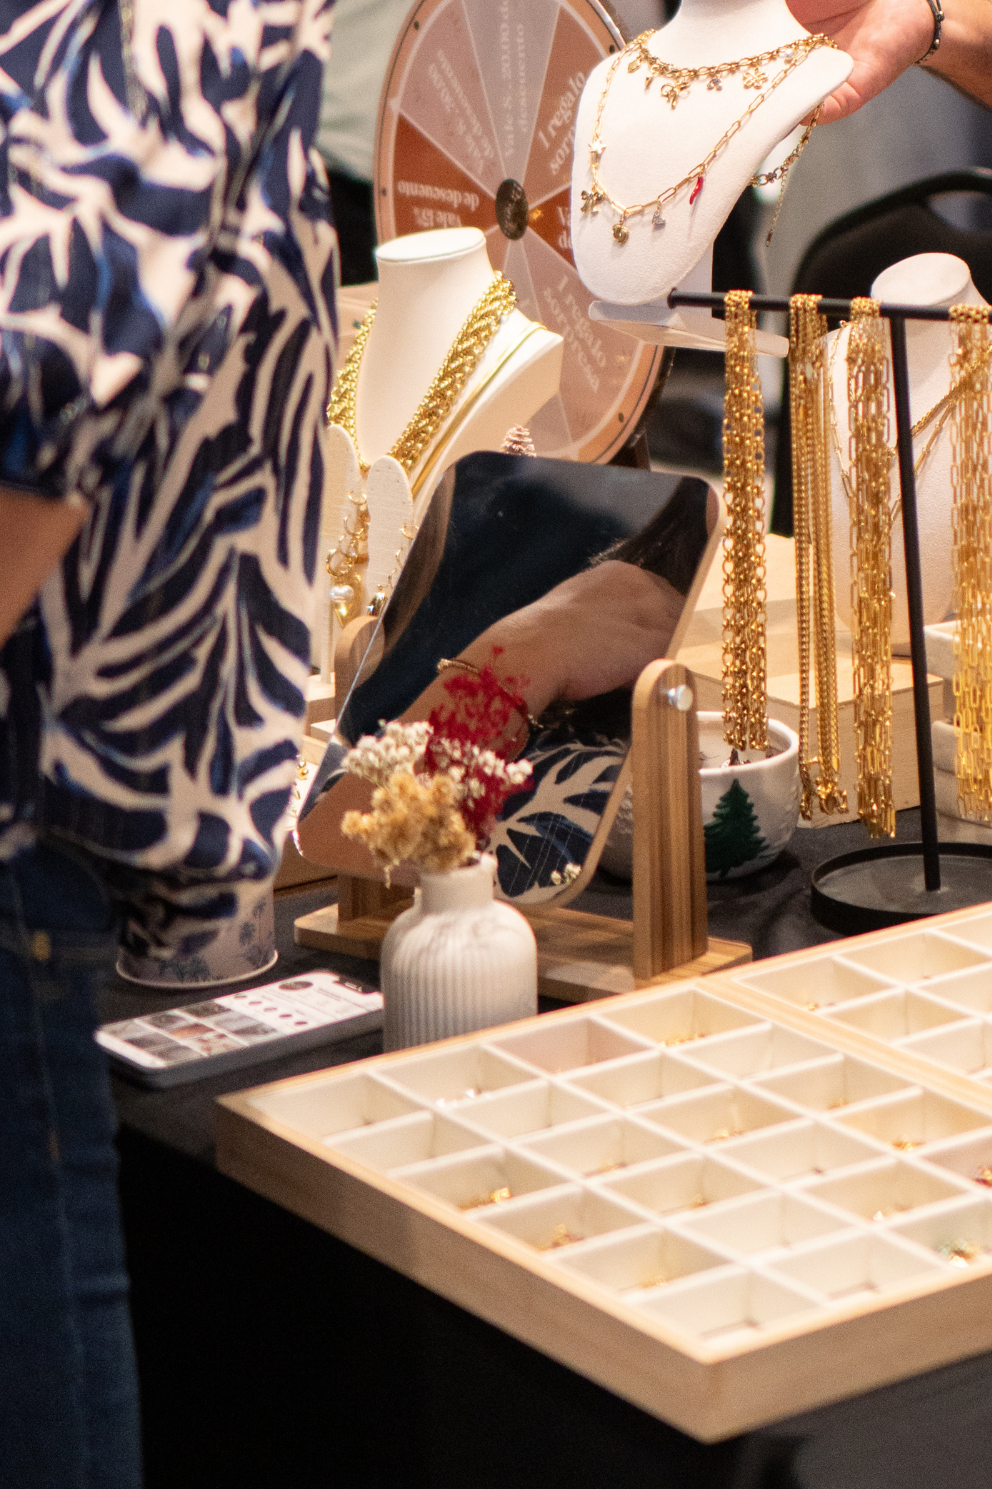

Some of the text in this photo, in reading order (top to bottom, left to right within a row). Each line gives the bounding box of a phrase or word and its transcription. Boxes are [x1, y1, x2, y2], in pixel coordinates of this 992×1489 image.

[538, 72, 586, 149] 1 regalo
[397, 180, 480, 212] de descuento
[544, 287, 600, 394] sorpresa
[565, 294, 606, 368] regalo
